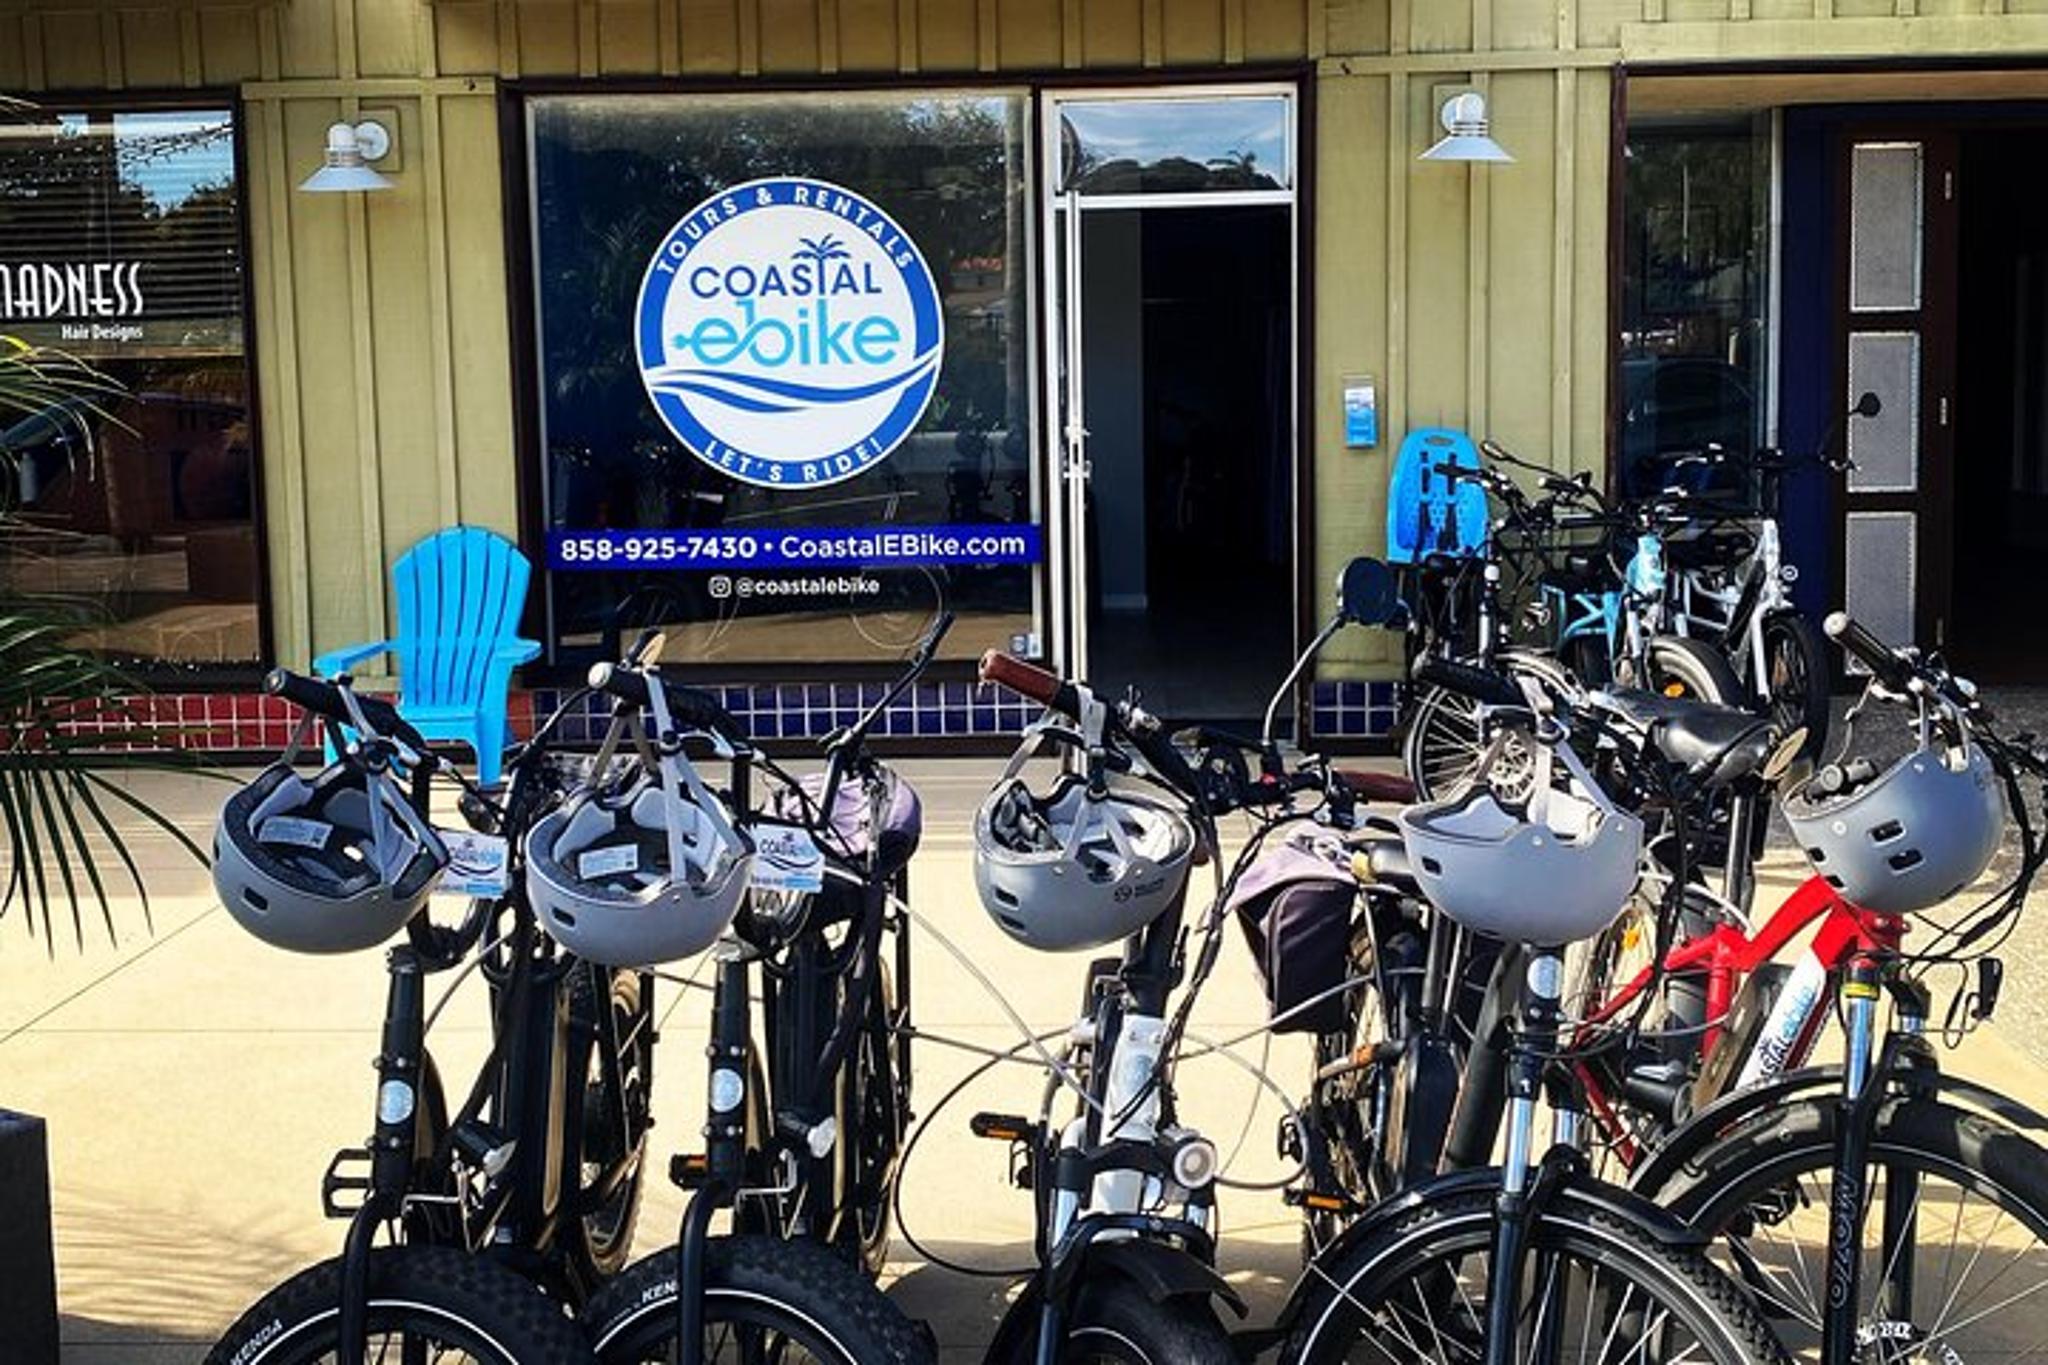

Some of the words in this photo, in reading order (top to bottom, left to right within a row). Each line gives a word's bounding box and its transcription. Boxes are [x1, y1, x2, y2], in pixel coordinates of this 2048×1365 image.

[657, 197, 738, 274] TOURS
[756, 186, 774, 205] &
[794, 185, 914, 268] RENTALS
[690, 249, 882, 298] COASTAL
[62, 323, 89, 339] Hair
[92, 323, 143, 342] Designs
[673, 299, 901, 367] ebike
[705, 440, 783, 482] LET'S
[802, 437, 883, 482] RIDE!
[561, 536, 757, 561] 858-925-7430
[780, 534, 1026, 559] CoastalEBike.com
[735, 576, 880, 598] @coastalebike
[642, 1281, 679, 1304] KEN
[230, 1318, 282, 1365] KENDA
